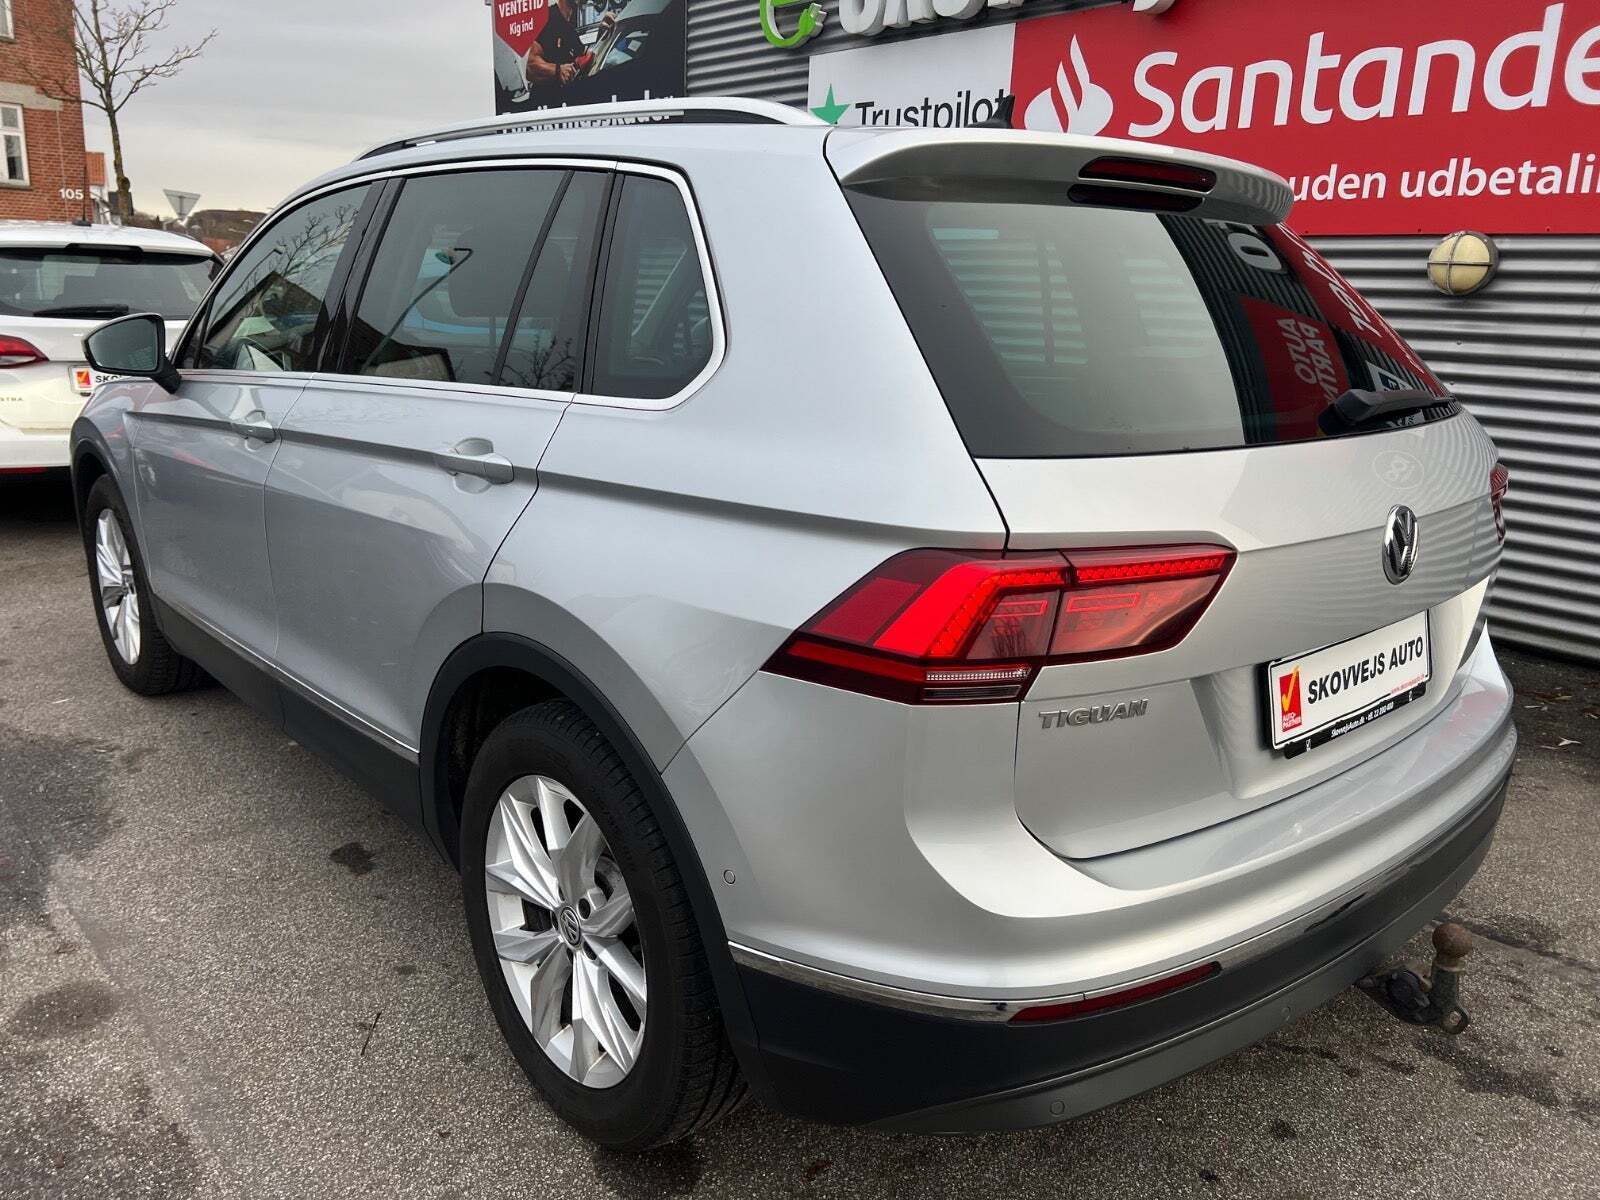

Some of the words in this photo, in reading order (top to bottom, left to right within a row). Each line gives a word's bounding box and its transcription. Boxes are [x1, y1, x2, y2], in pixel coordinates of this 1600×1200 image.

[509, 22, 521, 37] Kig
[521, 17, 534, 32] ind
[1400, 152, 1600, 198] udbetali
[59, 187, 84, 200] 105
[95, 374, 121, 383] SKO
[1307, 652, 1386, 704] SKOVVEJS
[1389, 636, 1424, 671] AUTO
[1038, 698, 1149, 729] TIGUAN
